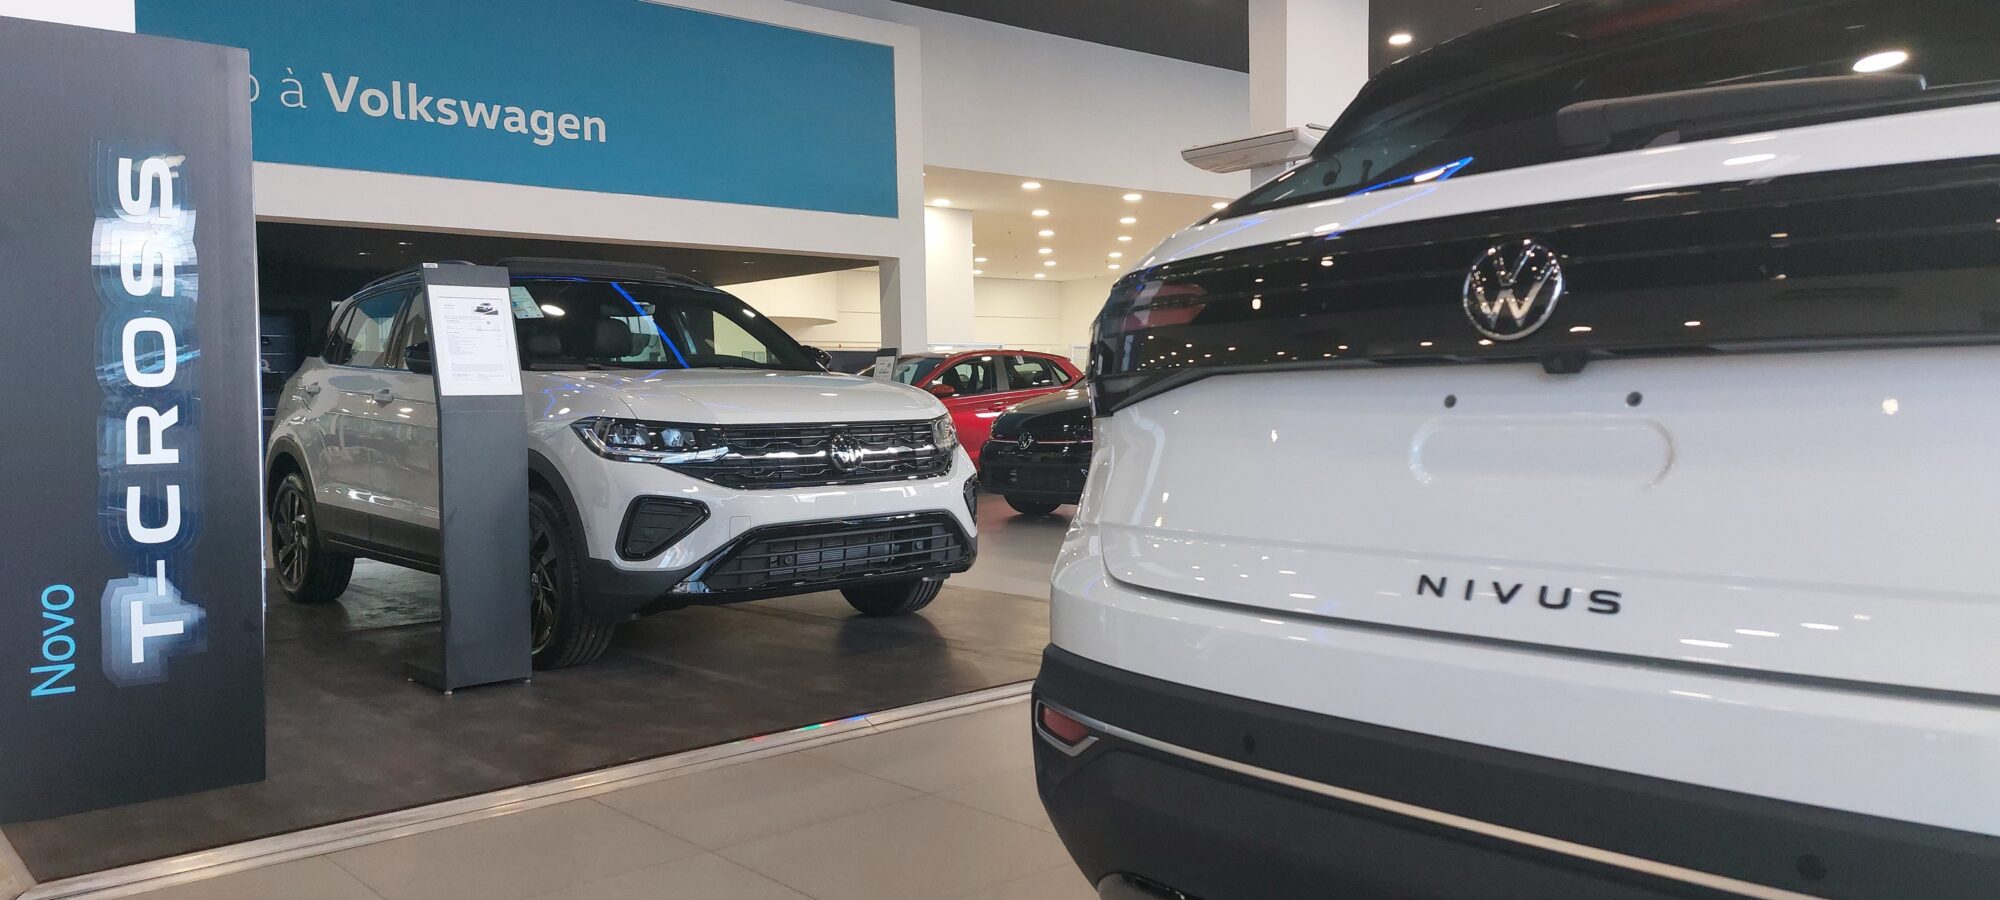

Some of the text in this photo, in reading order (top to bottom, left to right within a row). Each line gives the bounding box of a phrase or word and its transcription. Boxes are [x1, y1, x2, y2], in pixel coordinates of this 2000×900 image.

[281, 66, 307, 109] à
[321, 72, 607, 146] Volkswagen
[1465, 241, 1561, 338] VW
[118, 157, 184, 664] T-CROSS
[30, 583, 76, 697] Novo
[1417, 574, 1622, 615] NIVUS
